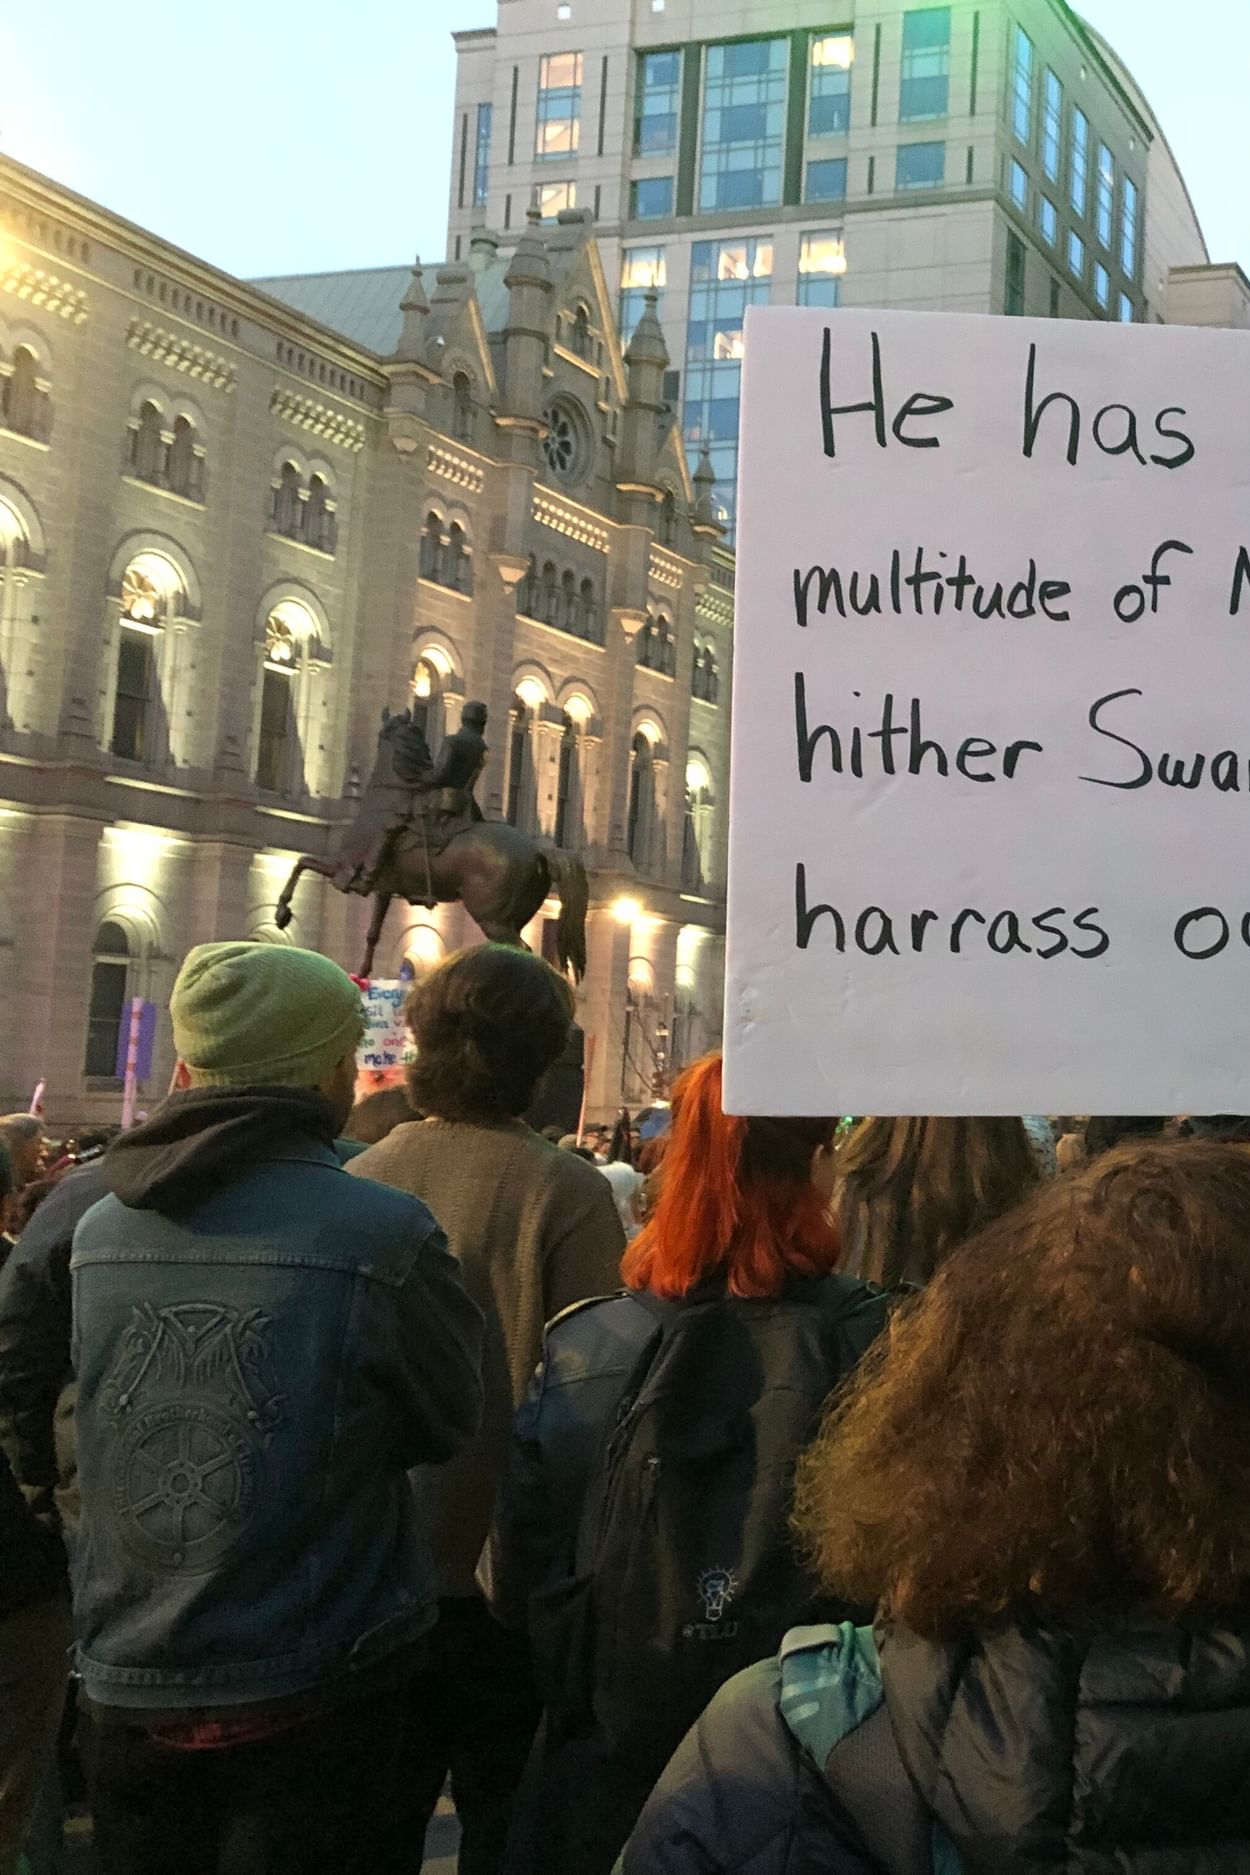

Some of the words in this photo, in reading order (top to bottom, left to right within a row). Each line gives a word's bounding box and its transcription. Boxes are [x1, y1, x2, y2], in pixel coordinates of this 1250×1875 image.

[820, 327, 954, 458] He
[1023, 343, 1195, 469] has
[794, 547, 1071, 627] multitude
[1114, 540, 1193, 623] of
[795, 672, 1043, 783] hither
[795, 863, 1109, 959] harrass
